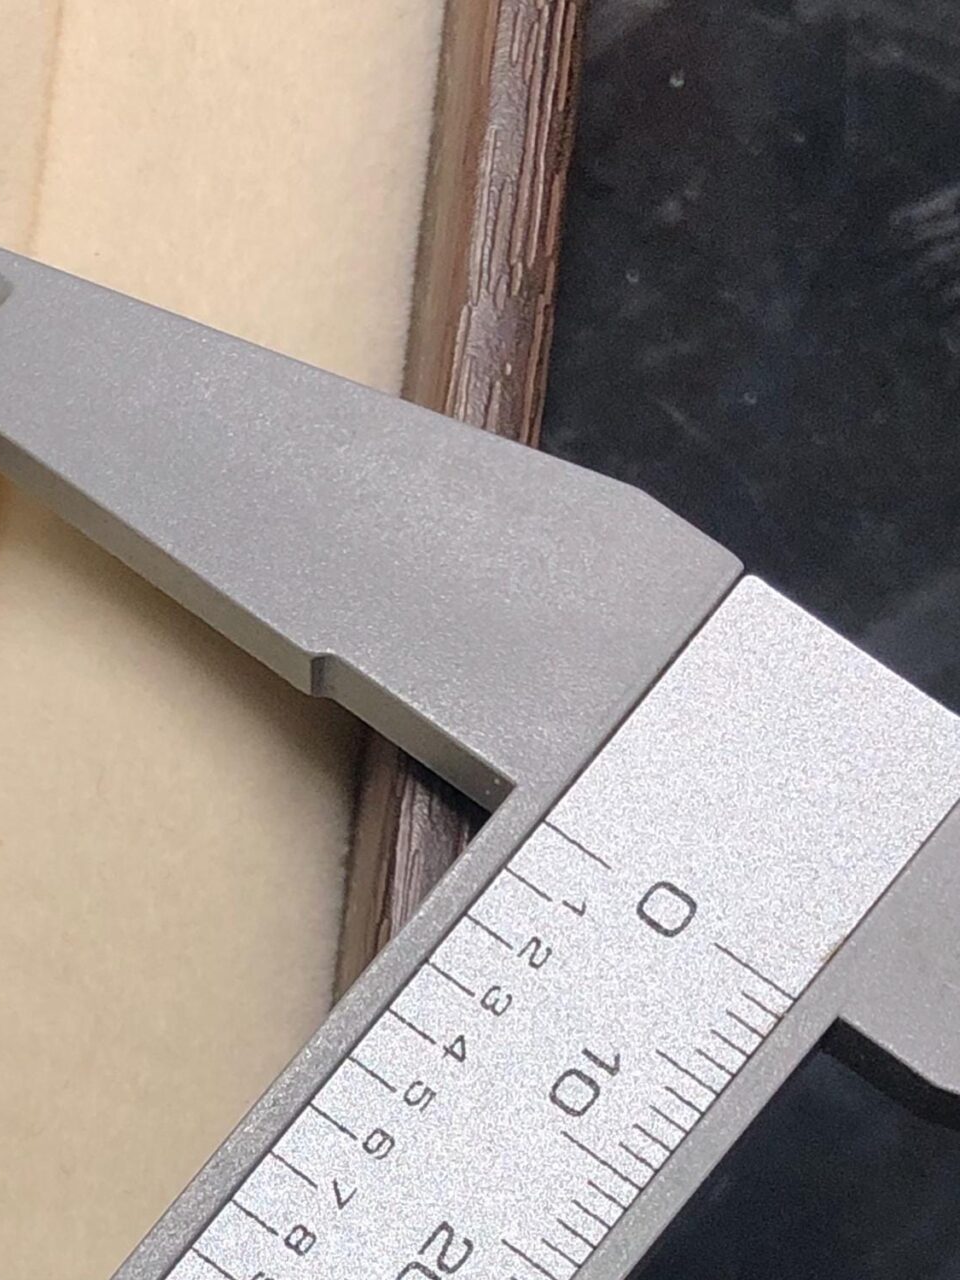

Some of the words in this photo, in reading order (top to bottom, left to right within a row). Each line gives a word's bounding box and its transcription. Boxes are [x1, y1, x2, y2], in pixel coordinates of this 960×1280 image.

[562, 900, 588, 918] 1
[636, 880, 698, 938] 0
[518, 936, 553, 970] 2
[480, 984, 514, 1018] 3
[443, 1033, 469, 1063] 4
[403, 1079, 436, 1108] 5
[549, 1047, 622, 1118] 10
[362, 1127, 396, 1160] 6
[329, 1181, 357, 1211] 7
[283, 1223, 318, 1258] 8
